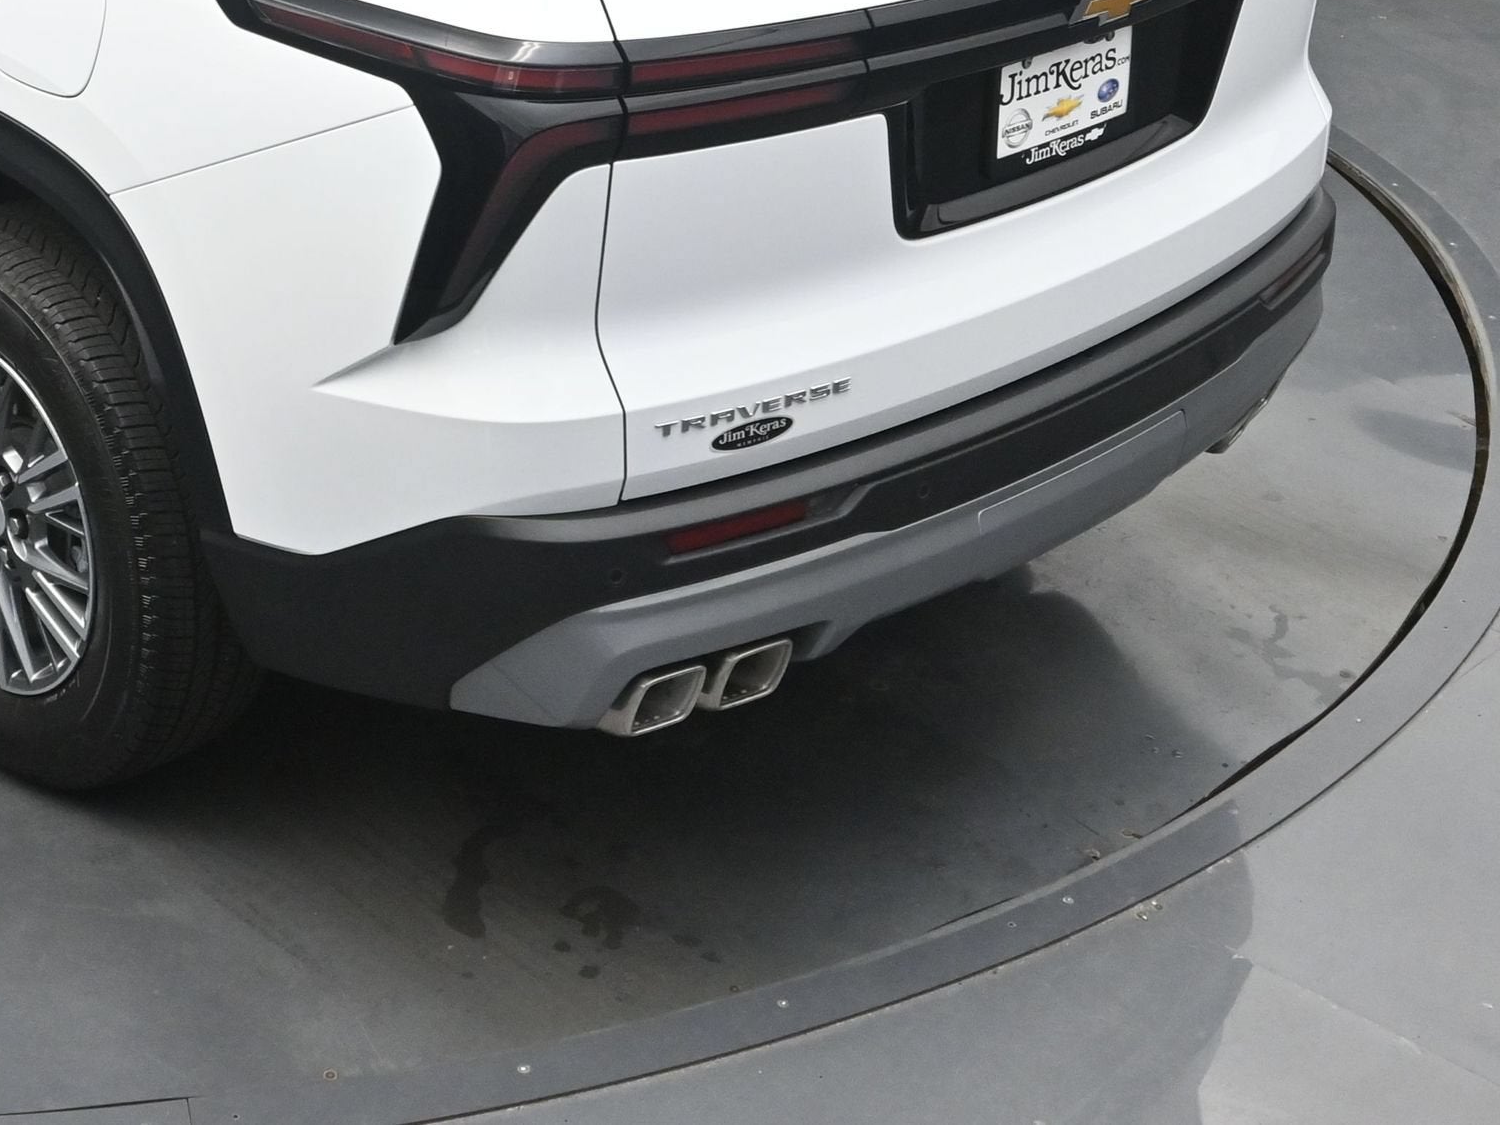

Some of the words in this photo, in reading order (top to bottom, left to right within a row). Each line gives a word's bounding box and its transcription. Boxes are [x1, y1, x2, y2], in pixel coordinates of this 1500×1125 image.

[1090, 99, 1123, 120] SUBARU
[1004, 122, 1031, 135] NISSAN
[1045, 119, 1079, 136] CHEVROLET
[654, 377, 852, 438] TRAVERSE
